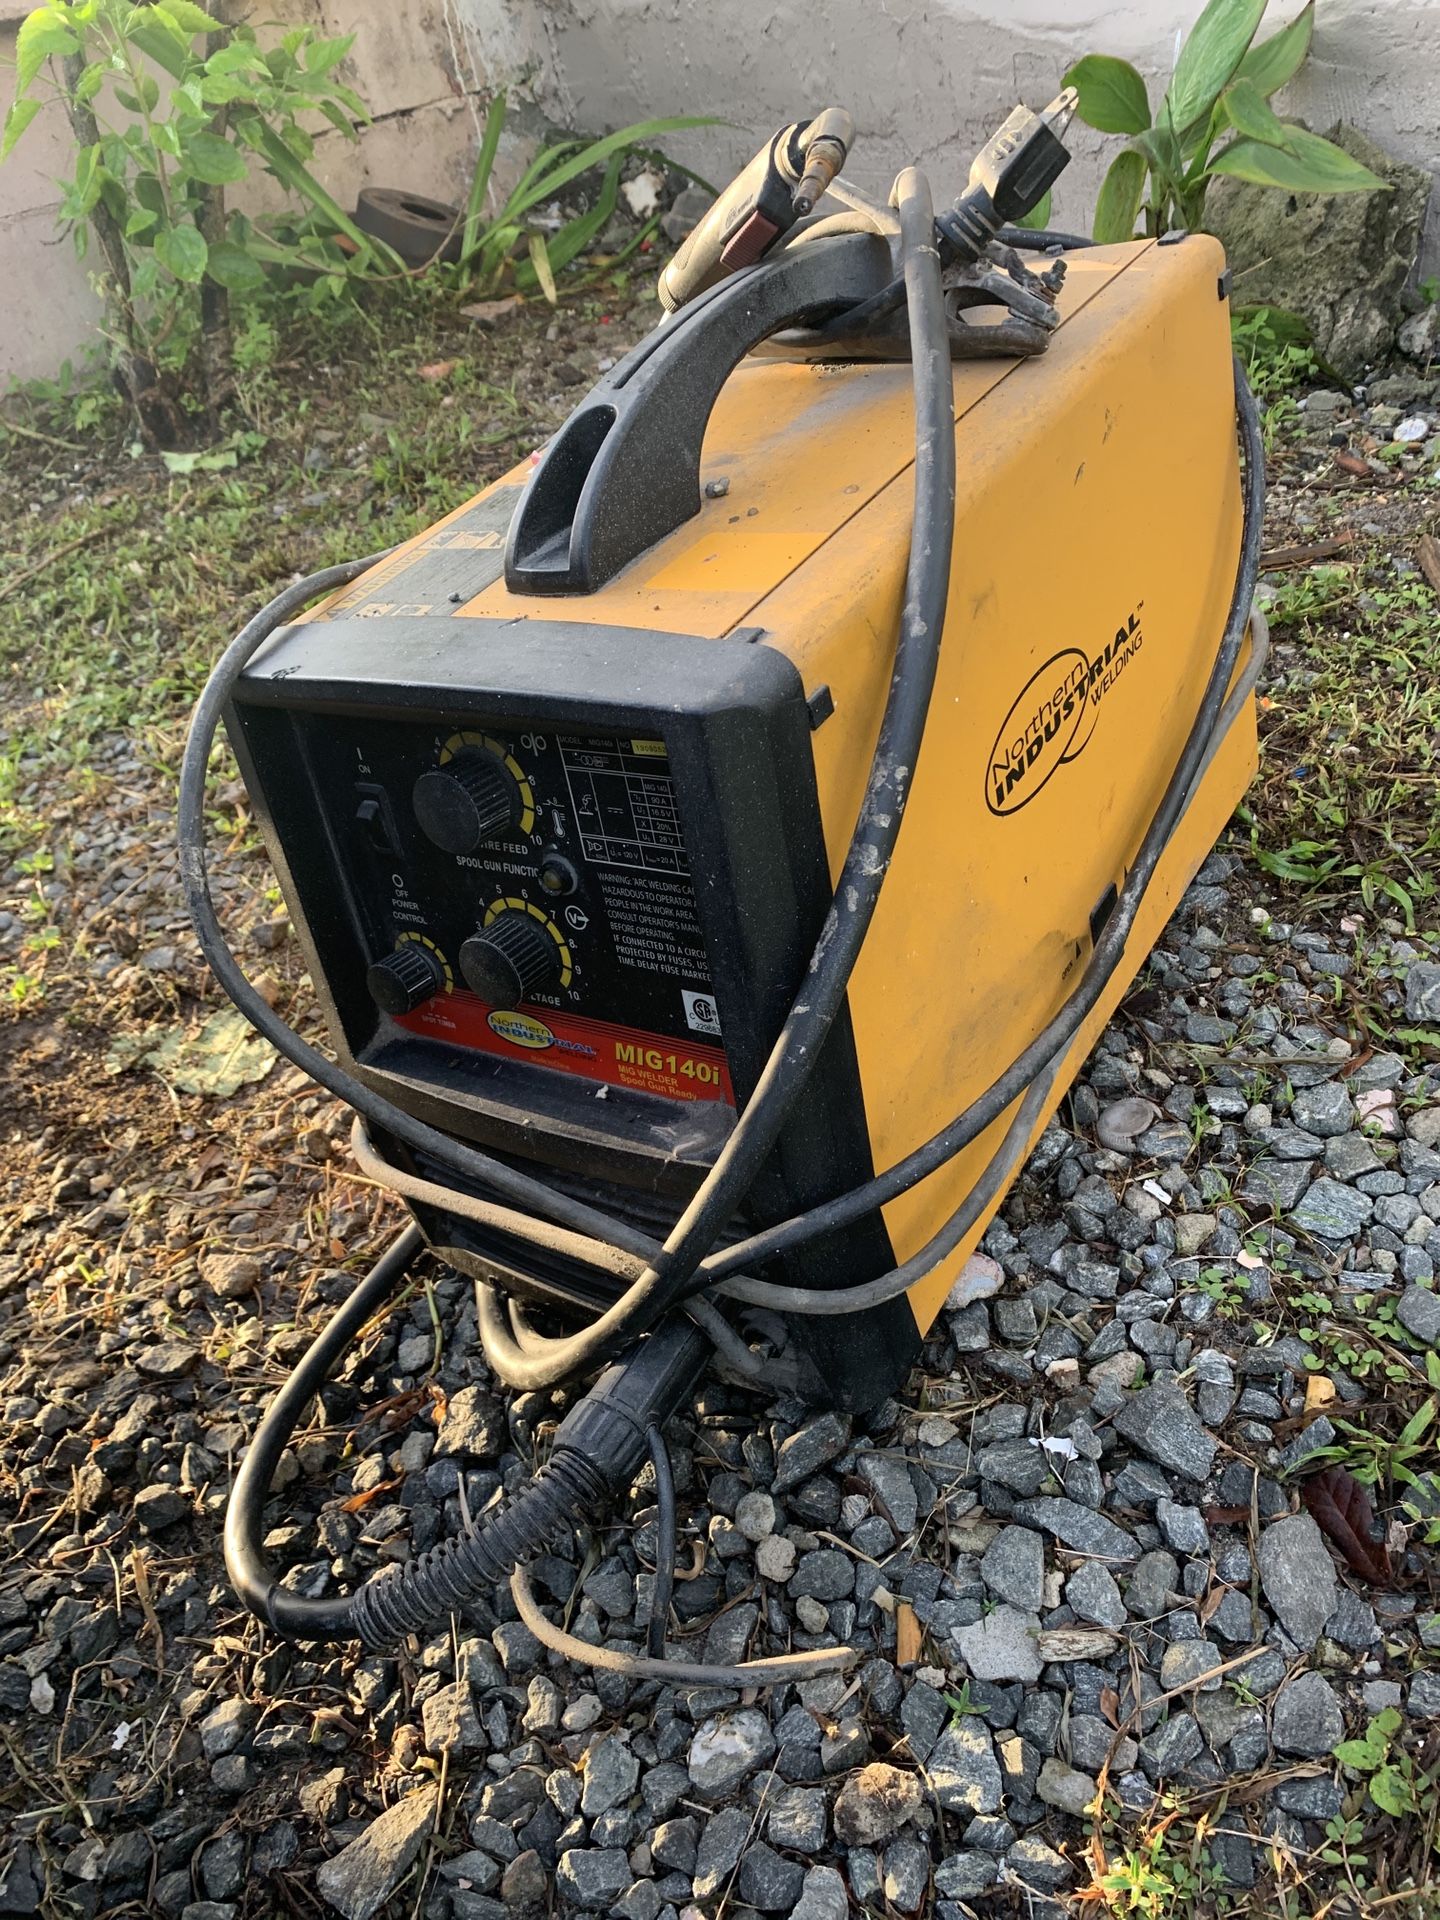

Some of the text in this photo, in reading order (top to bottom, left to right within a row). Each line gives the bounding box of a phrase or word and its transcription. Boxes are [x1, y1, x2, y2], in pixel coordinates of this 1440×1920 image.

[1090, 631, 1143, 707] WELDING
[995, 613, 1141, 807] INDUSTRIAL
[993, 661, 1084, 785] Northern
[509, 744, 515, 754] 7
[358, 764, 371, 774] ON
[528, 775, 536, 787] 8
[535, 805, 543, 816] 9
[530, 834, 543, 846] 10
[503, 842, 529, 855] FEED
[456, 855, 484, 870] SPOOL
[484, 860, 502, 872] GUN
[496, 884, 502, 894] 5
[648, 880, 681, 893] WELDING
[395, 889, 408, 898] OFF
[521, 889, 529, 899] 6
[601, 885, 645, 900] HAZARDOUS
[645, 891, 656, 901] TO
[655, 894, 693, 908] OPERATOR
[392, 898, 420, 910] POWER
[478, 898, 485, 907] 4
[604, 897, 630, 910] PEOPLE
[629, 901, 639, 911] IN
[639, 903, 653, 914] THE
[652, 905, 675, 917] WORK
[392, 910, 428, 925] CONTROL
[550, 910, 556, 920] 7
[607, 909, 638, 922] CONSULT
[638, 914, 681, 931] OPERATOR'S
[475, 921, 482, 931] 3
[609, 921, 636, 934] BEFORE
[568, 939, 575, 949] 8
[613, 934, 620, 942] IF
[621, 935, 664, 951] CONNECTED
[665, 943, 676, 953] TO
[677, 947, 684, 955] A
[615, 944, 656, 960] PROTECTED
[656, 953, 667, 962] BY
[574, 965, 582, 975] 9
[618, 955, 636, 968] TIME
[636, 959, 660, 972] DELAY
[660, 964, 681, 976] FUSE
[567, 990, 580, 1001] 10
[490, 1015, 551, 1036] Northern
[492, 1023, 594, 1055] INDUSTRIAL
[615, 1042, 720, 1086] MIG140i
[618, 1064, 679, 1088] MIG WELDER
[620, 1073, 698, 1101] Spool Gun Ready
